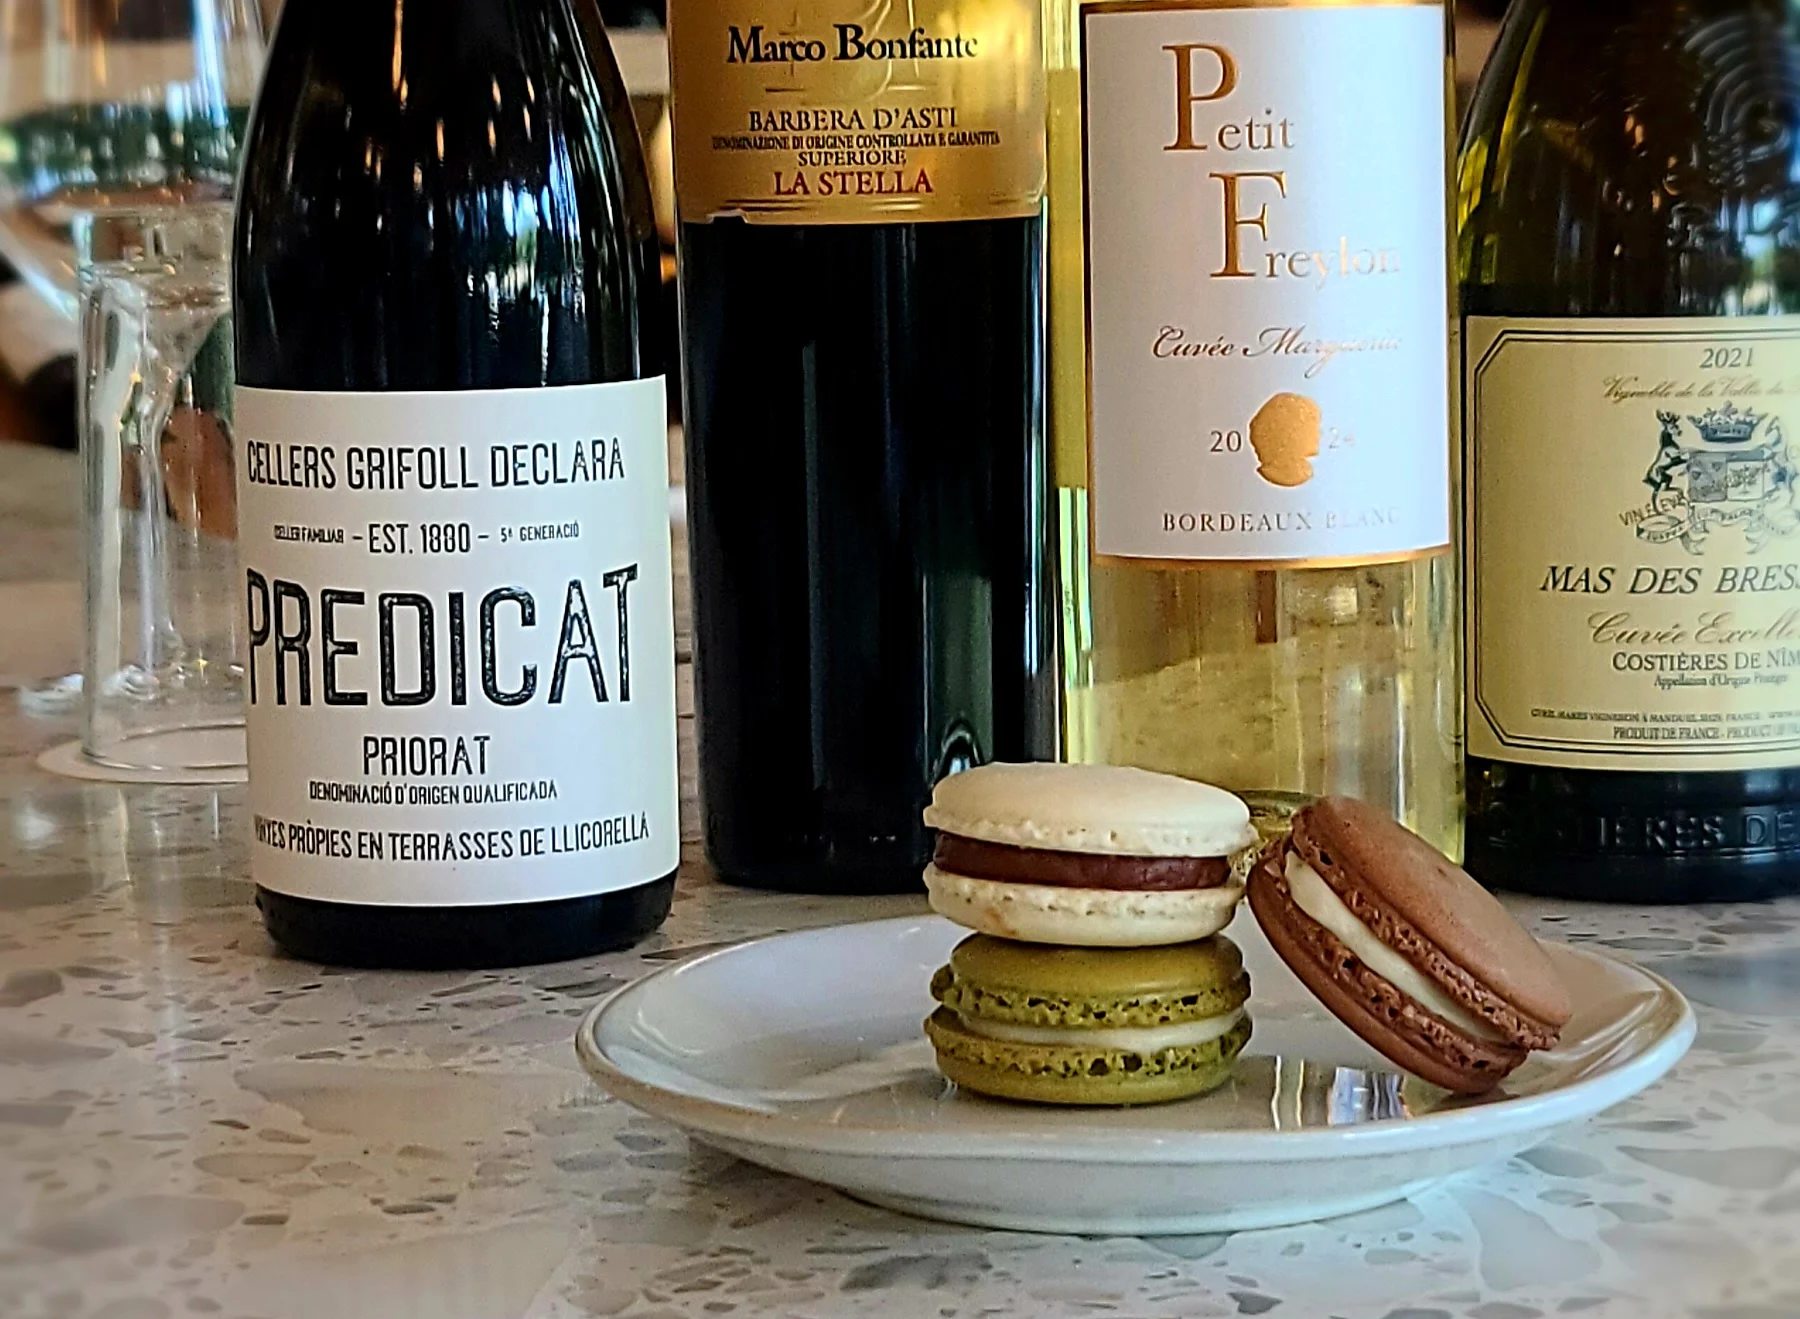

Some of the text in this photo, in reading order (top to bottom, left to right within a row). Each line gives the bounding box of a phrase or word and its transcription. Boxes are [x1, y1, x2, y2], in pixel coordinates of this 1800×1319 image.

[727, 24, 978, 63] Marco Bonfante
[1162, 43, 1295, 152] Petit
[749, 107, 958, 132] BARBERA D'ASTI
[792, 135, 804, 149] DI
[806, 134, 853, 149] ORIGINE
[856, 132, 936, 148] CONTROLLATA
[938, 132, 946, 147] E
[948, 130, 1000, 146] GARANTITA
[798, 151, 906, 167] SUPERIORE
[774, 168, 933, 196] LA STELLA
[1209, 171, 1400, 290] Freylon
[1153, 325, 1236, 359] Cuvée
[1699, 347, 1755, 369] 2021
[1210, 430, 1243, 453] 20
[247, 437, 625, 489] CELLERS GRIFOLL DECLARA
[368, 524, 413, 554] EST.
[420, 523, 470, 553] 1880
[519, 520, 579, 542] GENERACIÓ
[1163, 512, 1312, 532] BORDEAUX
[1540, 566, 1615, 593] MAS
[1627, 566, 1703, 594] DES
[247, 563, 638, 706] PREDICAT
[1588, 611, 1688, 646] Cuvée
[1735, 651, 1762, 670] DE
[363, 735, 490, 776] PRIORAT
[309, 780, 558, 805] DENOMINACIÓ D'ORIGEN QUALIFICADA
[288, 820, 353, 858] PRÒPIES
[357, 832, 384, 860] EN
[387, 831, 513, 862] TERRASSES
[520, 828, 546, 857] DE
[551, 811, 650, 853] LLICORELLA
